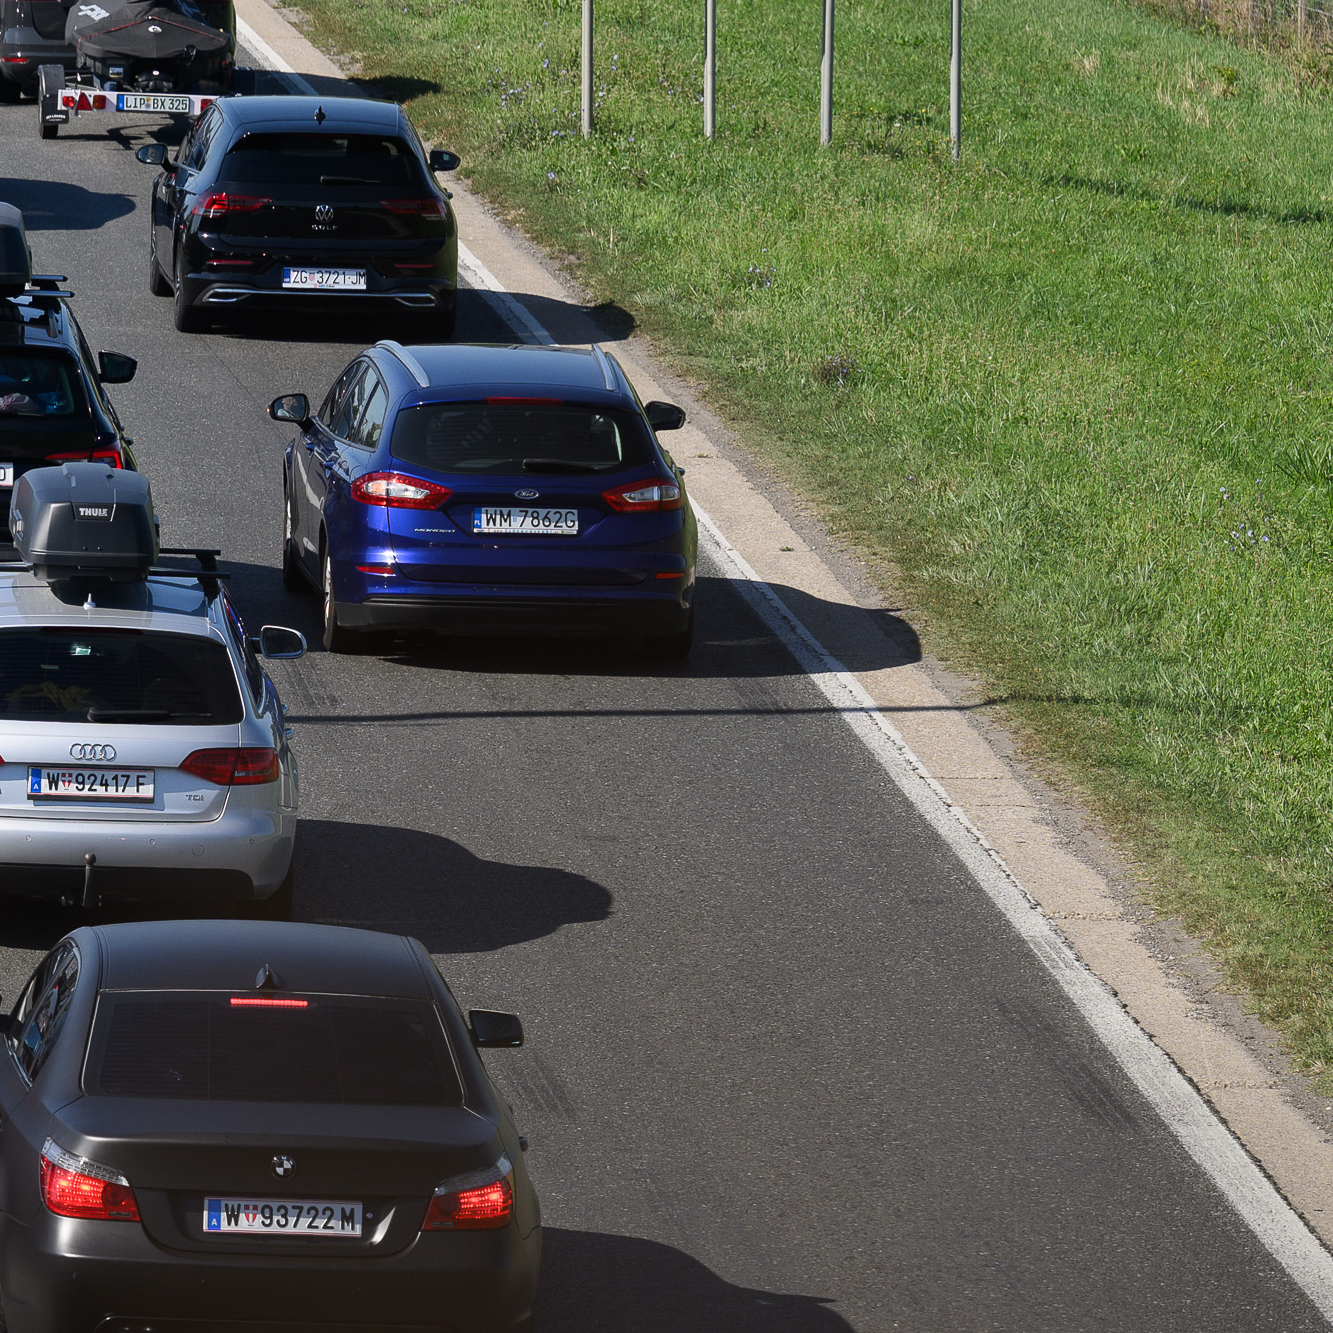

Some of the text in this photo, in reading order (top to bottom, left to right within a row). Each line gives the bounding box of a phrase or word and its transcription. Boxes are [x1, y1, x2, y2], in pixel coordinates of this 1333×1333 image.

[125, 98, 188, 110] LIP BX 325
[292, 270, 308, 283] ZG
[79, 508, 108, 516] THULE
[485, 510, 512, 527] WM
[518, 510, 576, 529] 7862G
[47, 772, 61, 791] W
[74, 772, 131, 793] 92417
[135, 774, 146, 793] F
[224, 1203, 241, 1227] W
[261, 1206, 335, 1230] 93722
[340, 1208, 355, 1231] M
